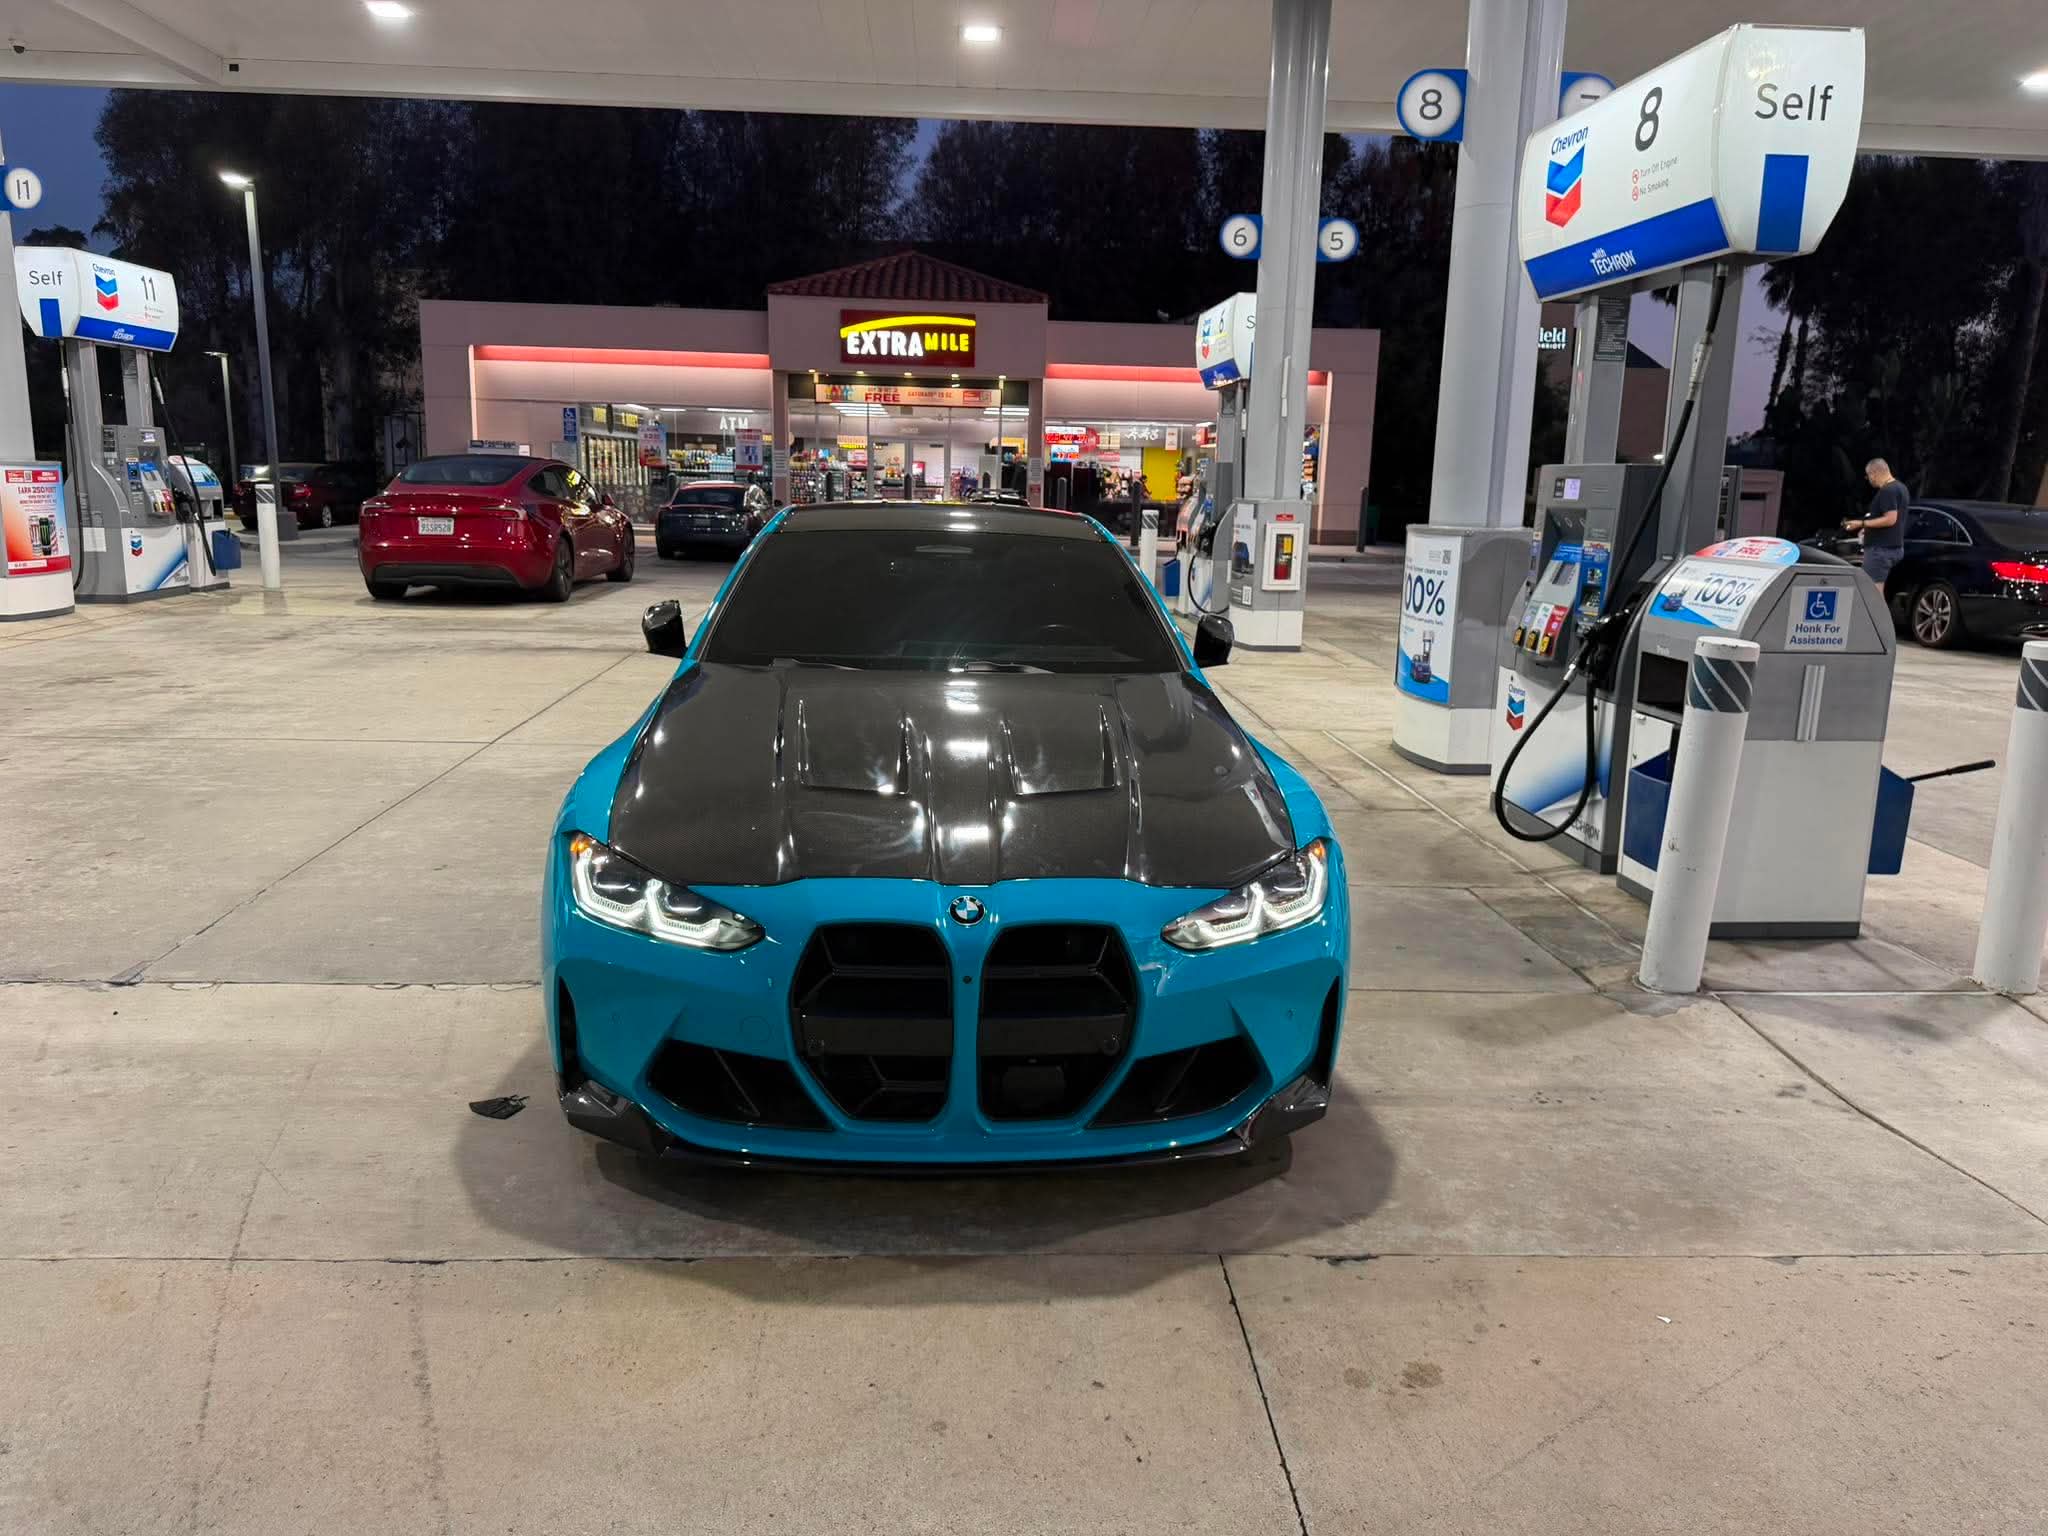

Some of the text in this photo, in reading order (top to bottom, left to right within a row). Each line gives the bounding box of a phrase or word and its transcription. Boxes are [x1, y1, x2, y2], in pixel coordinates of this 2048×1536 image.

[1419, 88, 1443, 121] 8
[1754, 82, 1834, 122] Self
[1634, 86, 1663, 152] 8
[1551, 125, 1589, 156] Chevron
[16, 179, 31, 200] 11
[1233, 227, 1247, 246] 6
[1329, 231, 1344, 251] 5
[1590, 250, 1636, 276] TECHRON
[28, 270, 64, 286] Self
[140, 275, 156, 302] 11
[864, 392, 901, 402] FREE
[719, 415, 749, 430] ATM
[1694, 577, 1754, 607] 100%
[1795, 623, 1841, 634] Honk For
[1789, 634, 1844, 646] Assistance
[1508, 684, 1526, 697] Chevron
